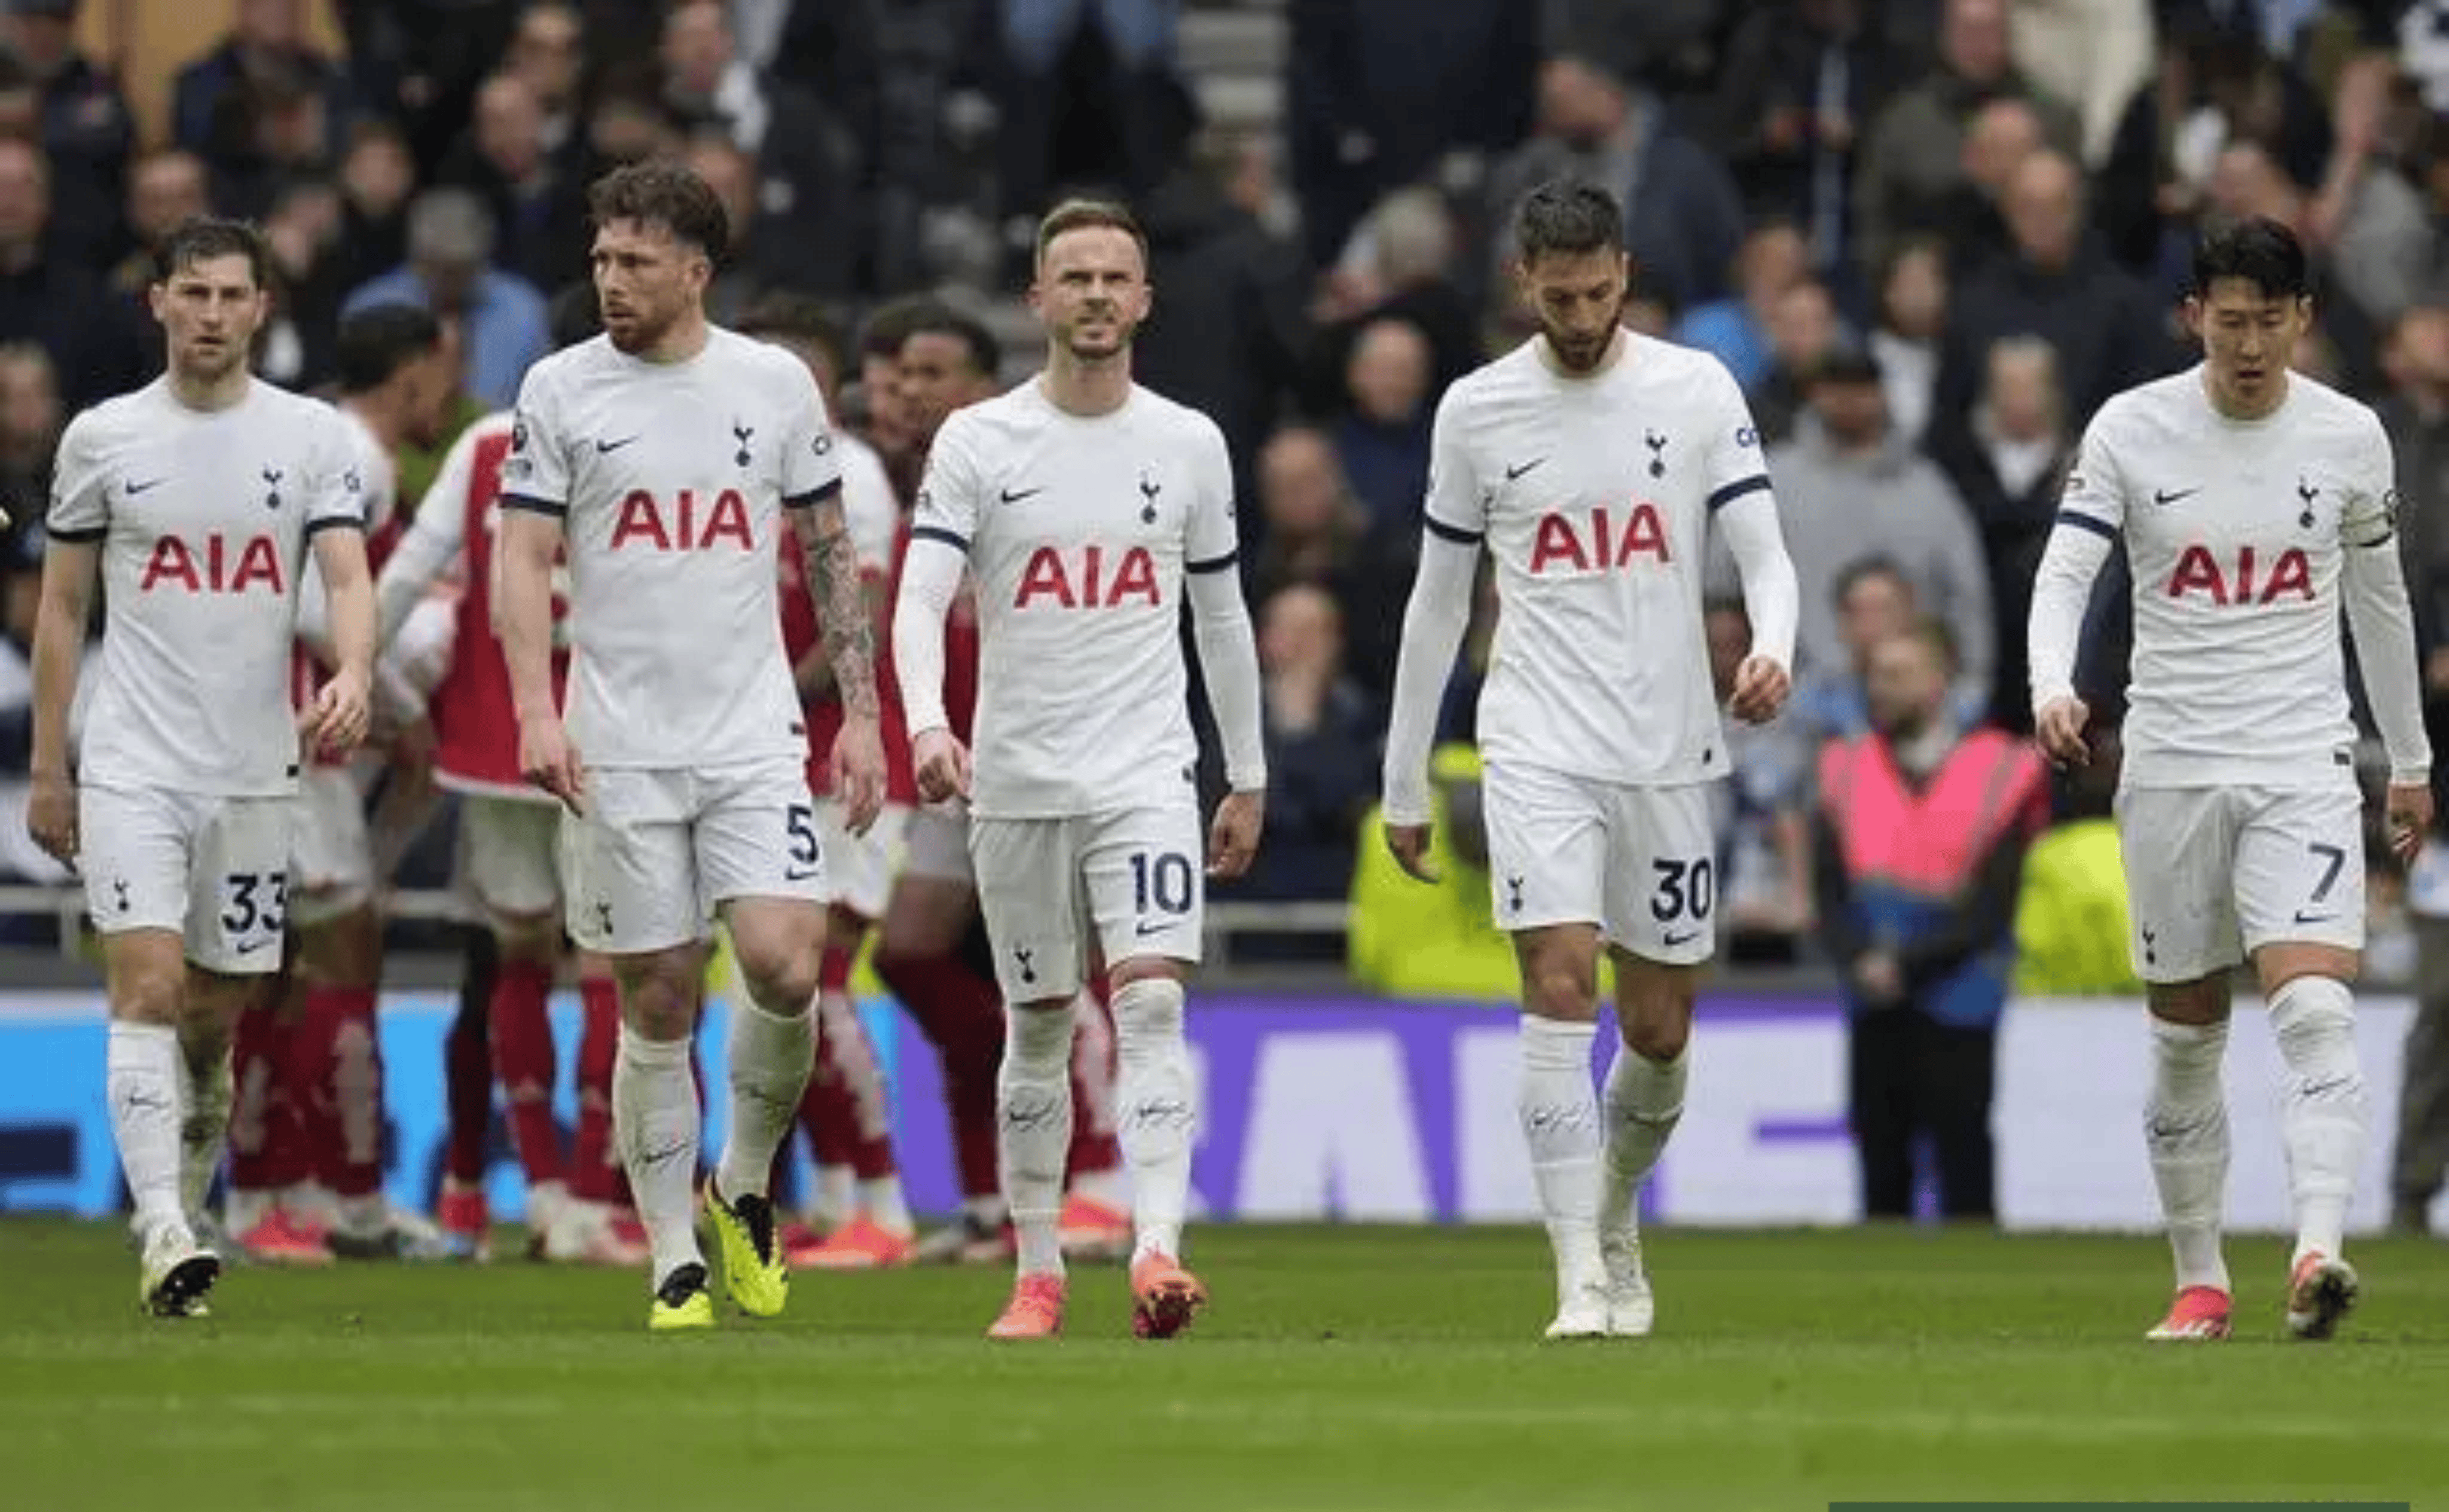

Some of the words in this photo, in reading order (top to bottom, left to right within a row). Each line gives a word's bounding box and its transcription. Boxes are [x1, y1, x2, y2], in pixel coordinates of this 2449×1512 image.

[611, 488, 753, 551] AIA
[1529, 502, 1668, 573] AIA
[142, 534, 283, 593] AIA
[1014, 546, 1161, 608] AIA
[2167, 546, 2313, 604] AIA
[787, 805, 819, 863] 5
[222, 872, 286, 934] 33
[1129, 853, 1193, 914] 10
[1650, 857, 1712, 923] 30
[2307, 844, 2345, 903] 7
